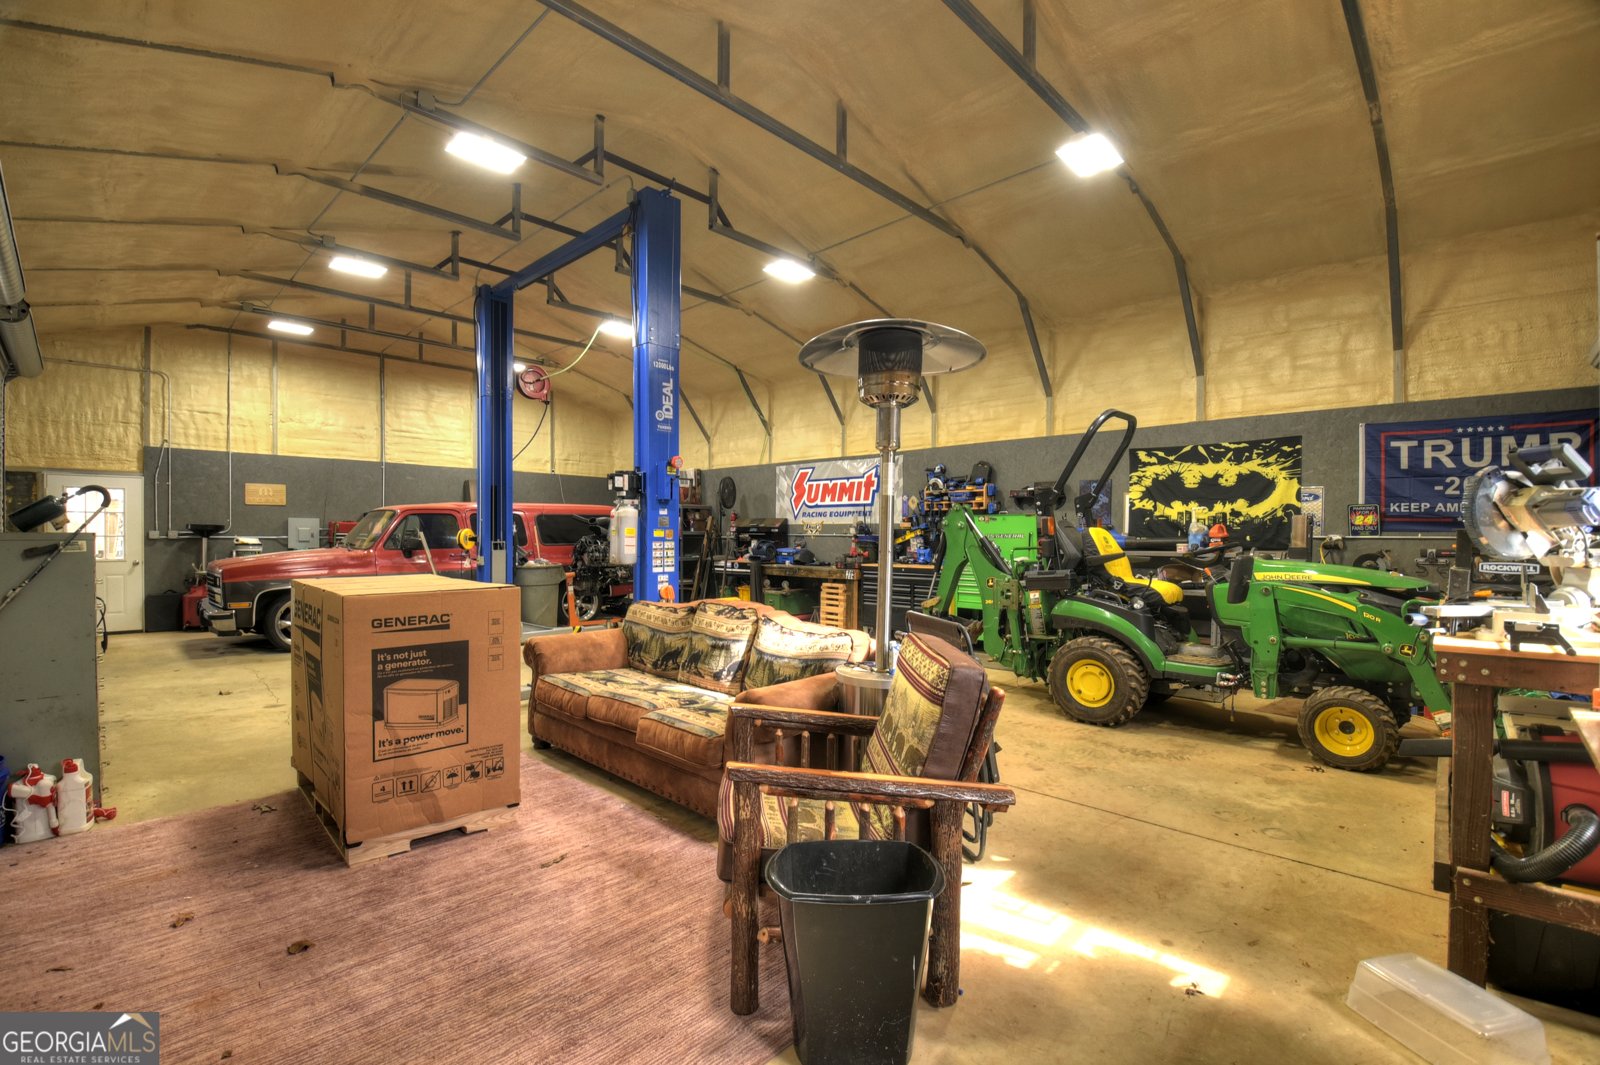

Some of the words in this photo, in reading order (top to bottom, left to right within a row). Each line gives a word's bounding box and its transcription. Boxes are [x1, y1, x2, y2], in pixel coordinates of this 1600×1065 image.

[1389, 502, 1430, 513] KEEP
[802, 510, 828, 518] RACING
[1354, 514, 1374, 526] 24
[1482, 564, 1536, 572] ROCKWLL
[371, 613, 451, 629] GENERAC
[377, 653, 391, 662] It's
[393, 651, 408, 660] not
[409, 649, 427, 661] just
[385, 658, 432, 671] generator.
[378, 738, 393, 749] It's
[403, 731, 434, 747] power
[435, 726, 464, 738] move.
